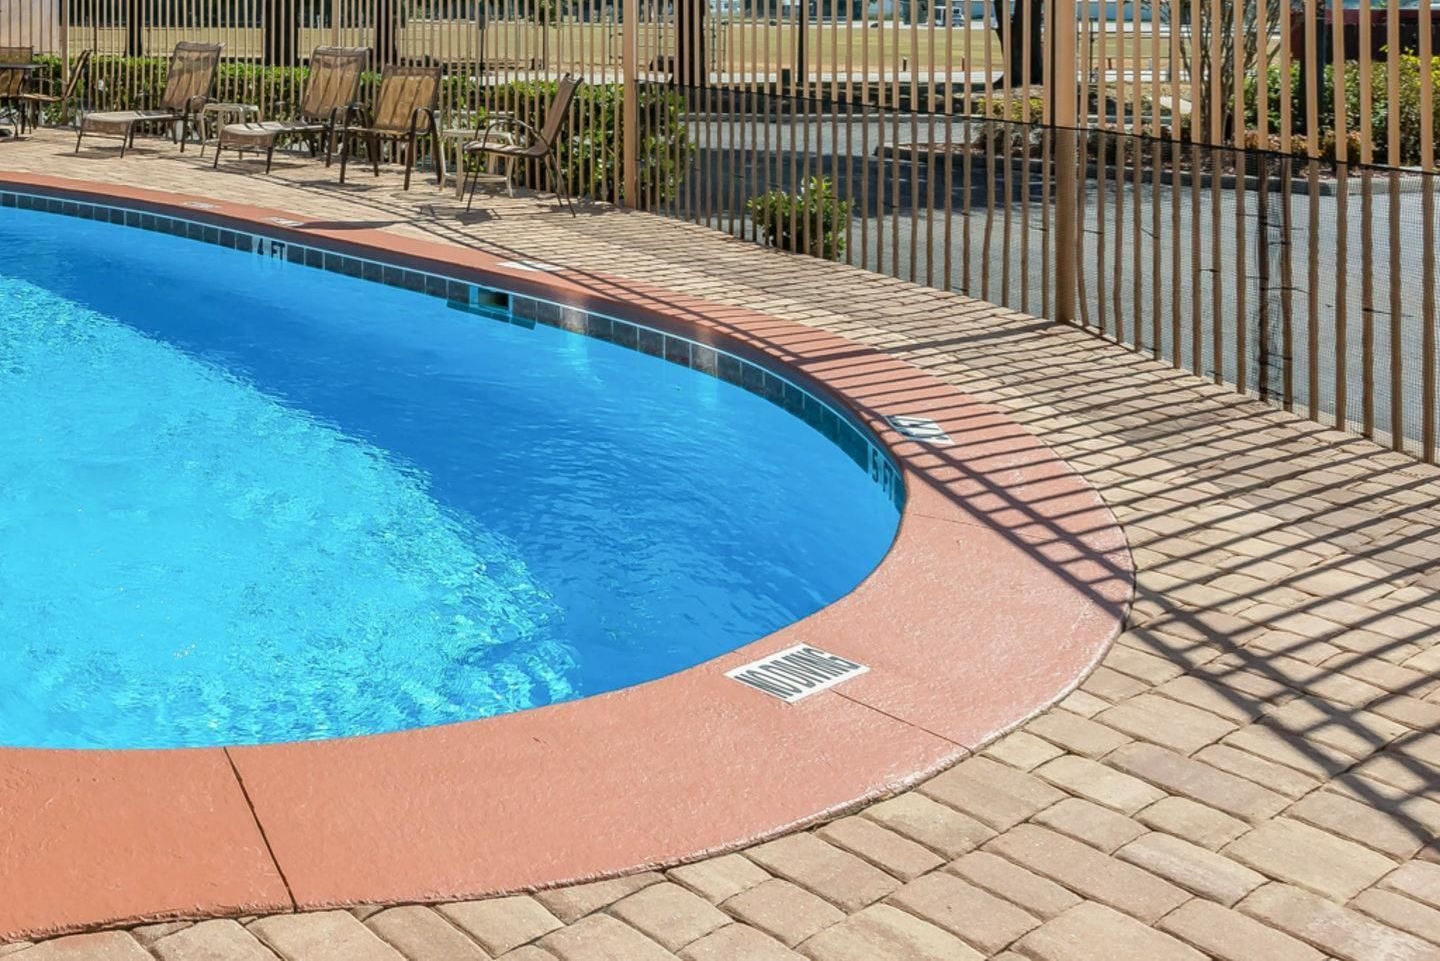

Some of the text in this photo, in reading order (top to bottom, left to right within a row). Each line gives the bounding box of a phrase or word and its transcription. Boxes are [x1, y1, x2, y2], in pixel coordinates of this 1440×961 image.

[271, 241, 286, 260] FT
[733, 647, 861, 699] NO DIVING
